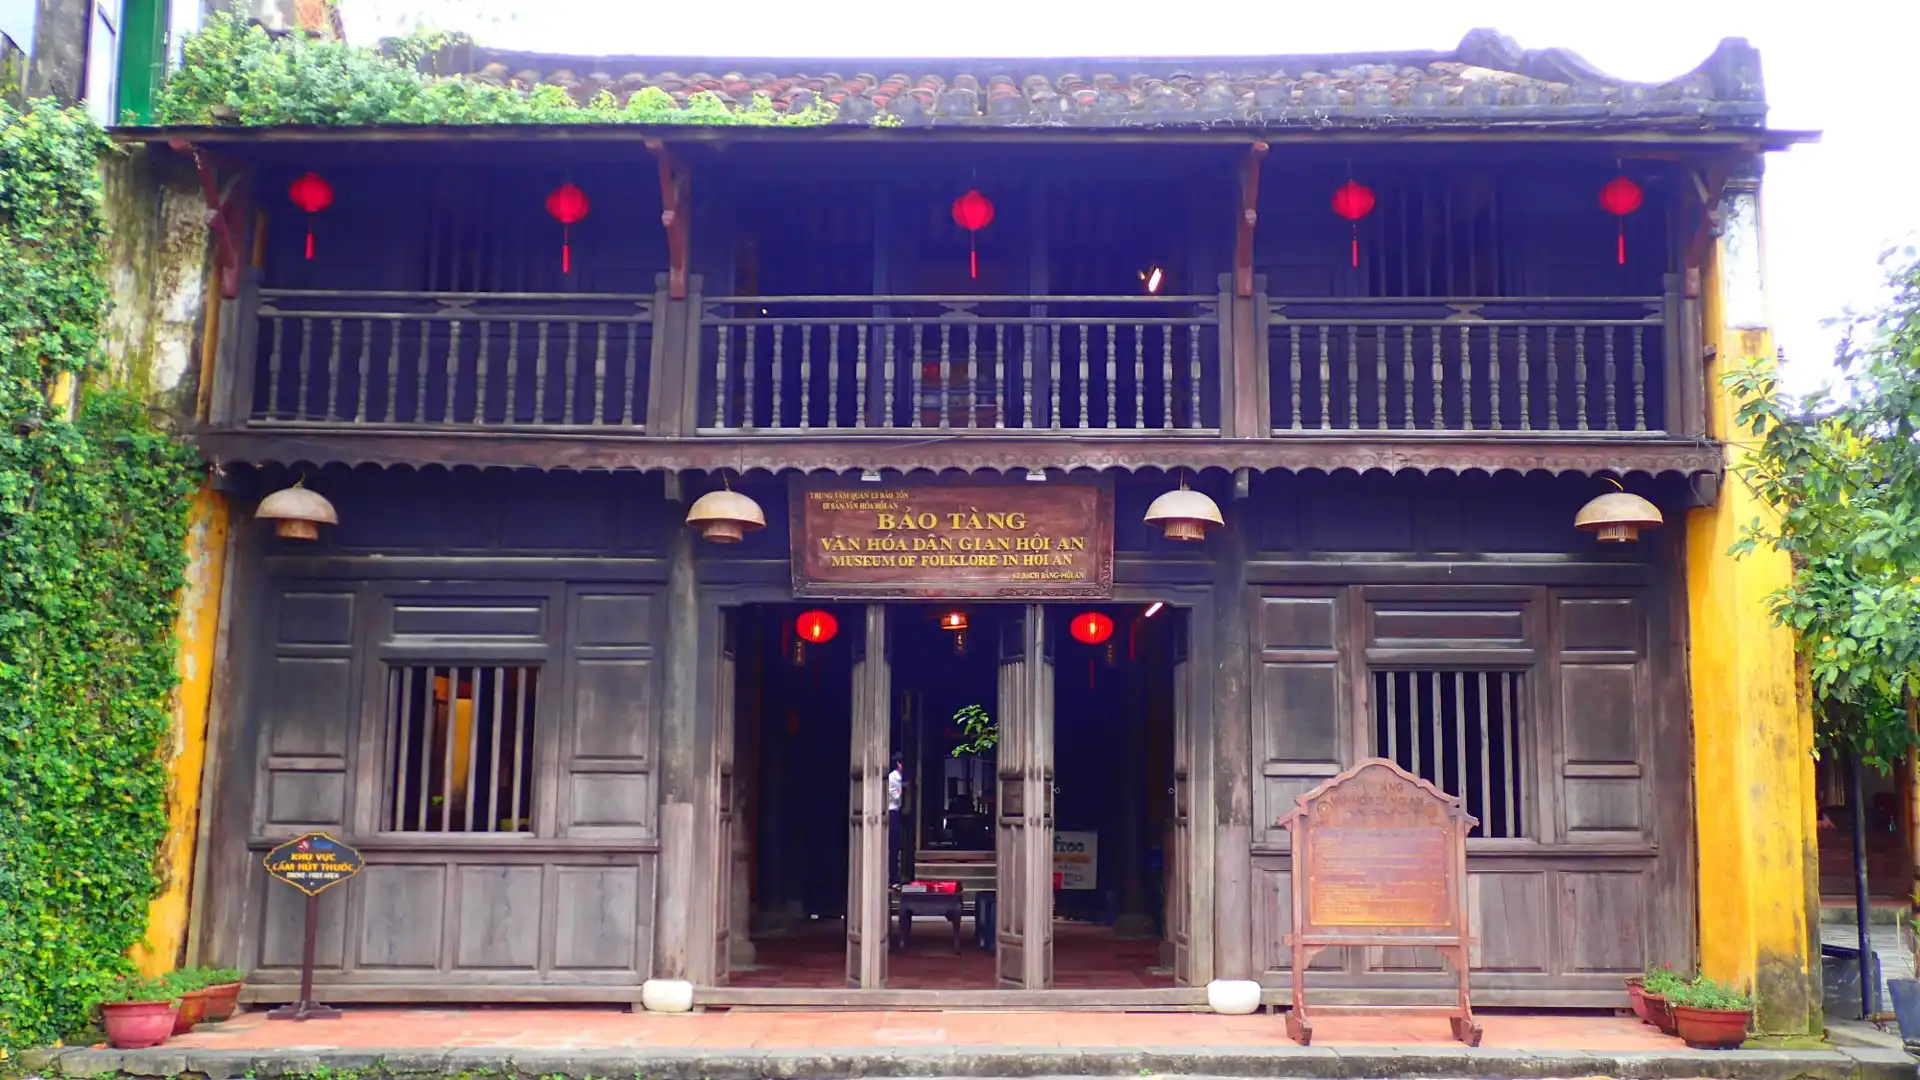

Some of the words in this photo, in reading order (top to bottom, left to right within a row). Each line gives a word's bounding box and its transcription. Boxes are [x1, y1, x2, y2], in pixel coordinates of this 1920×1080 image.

[877, 505, 938, 530] BẢO
[947, 506, 1027, 530] TÀNG
[821, 534, 860, 551] VĂN
[866, 532, 908, 551] HÓA
[912, 533, 953, 551] DÂN
[958, 537, 1010, 551] GIAN
[1016, 532, 1051, 553] HỘI
[1056, 536, 1085, 551] AN
[831, 554, 895, 567] MUSEUM
[898, 554, 916, 567] OF
[920, 554, 998, 567] FOLKLORE
[1003, 554, 1019, 566] IN
[1052, 554, 1073, 566] AN
[291, 853, 313, 861] KHU
